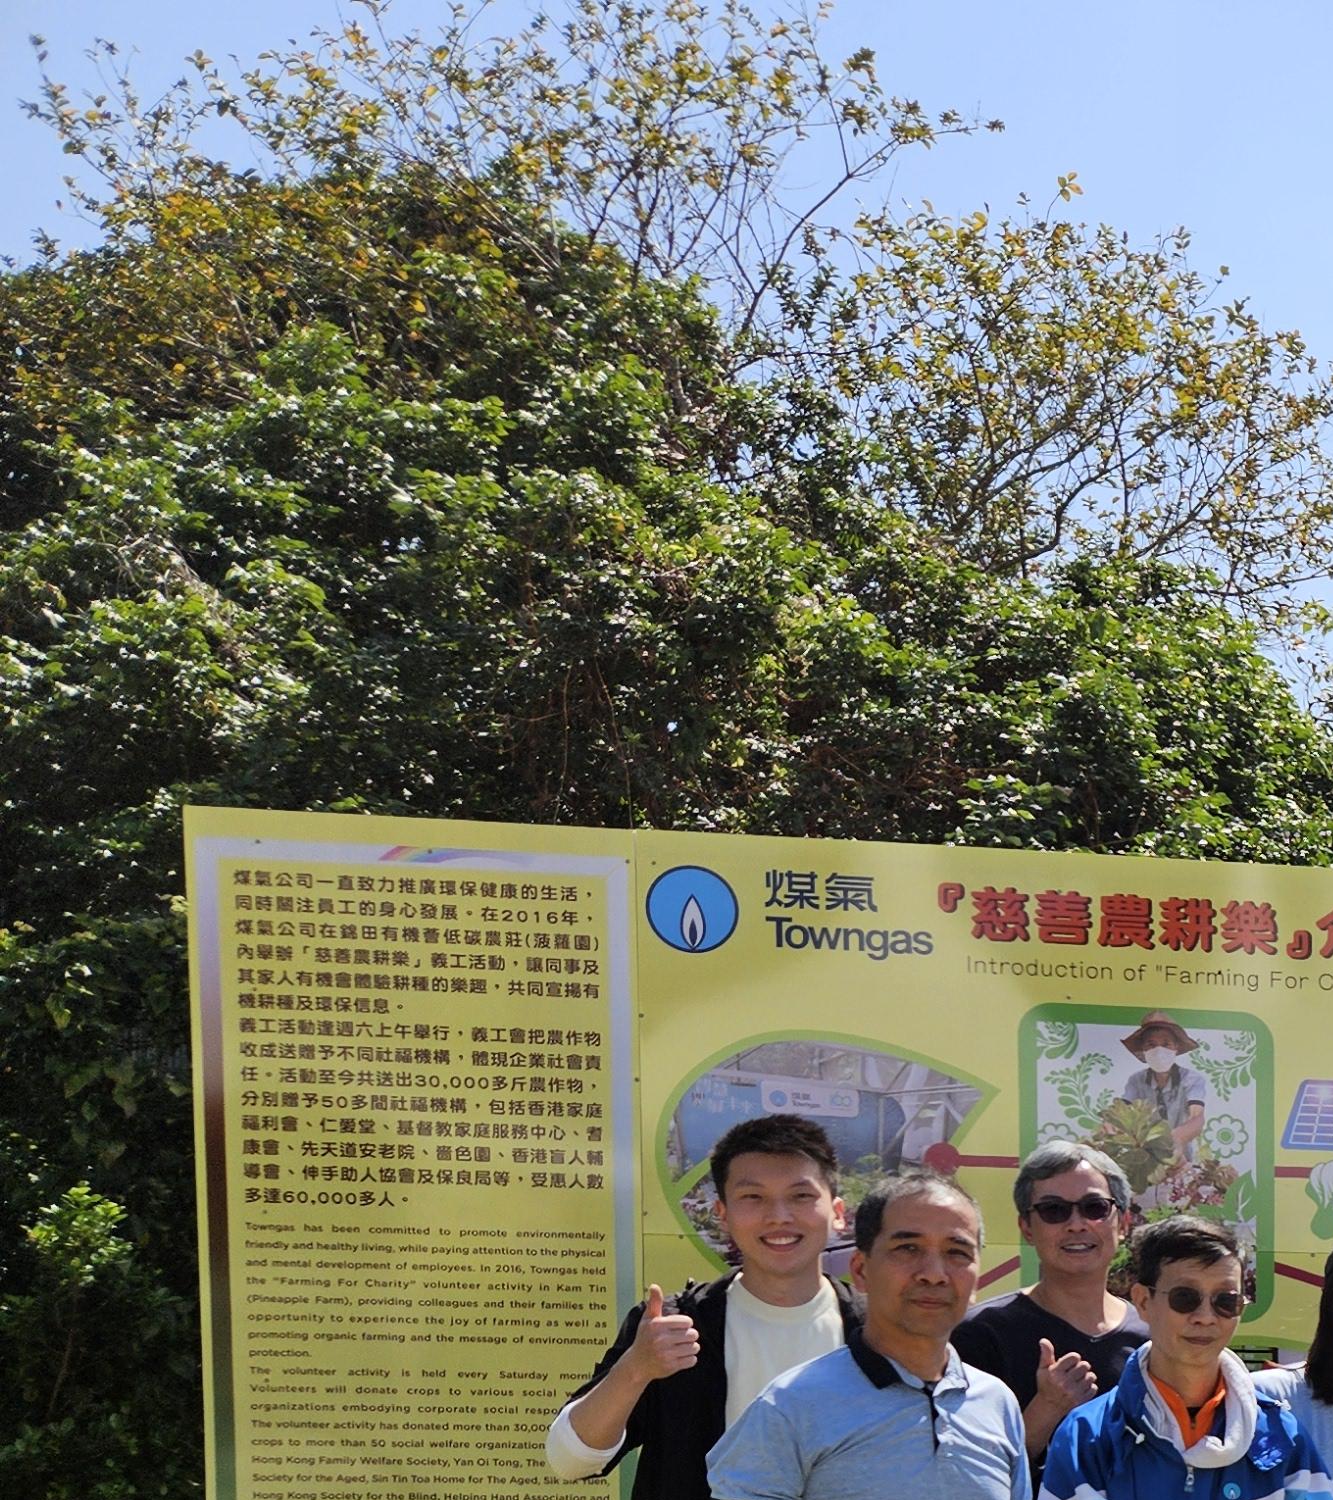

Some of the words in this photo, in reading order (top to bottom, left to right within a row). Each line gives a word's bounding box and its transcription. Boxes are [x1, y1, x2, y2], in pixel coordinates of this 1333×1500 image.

[765, 869, 878, 912] 煤氣
[765, 916, 934, 961] Towngas
[966, 955, 1113, 981] Introduction
[1123, 964, 1147, 982] of
[1155, 964, 1260, 992] "Farming
[1270, 970, 1310, 990] For
[245, 1221, 294, 1233] Towngas
[303, 1223, 323, 1232] has
[331, 1224, 360, 1233] been
[368, 1225, 430, 1235] committed
[458, 1228, 507, 1239] promote
[515, 1229, 605, 1241] environmentally
[244, 1239, 289, 1250] friendly
[292, 1241, 314, 1250] and
[316, 1241, 359, 1252] healthy
[398, 1244, 428, 1252] while
[430, 1245, 470, 1256] paying
[472, 1245, 524, 1257] attention
[560, 1247, 605, 1259] physical
[245, 1258, 268, 1267] and
[272, 1259, 311, 1268] mental
[315, 1260, 391, 1271] development
[529, 1264, 578, 1276] Towngas
[581, 1266, 606, 1276] held
[246, 1276, 266, 1284] the
[337, 1277, 358, 1287] For
[423, 1280, 480, 1290] volunteer
[487, 1281, 533, 1293] activity
[556, 1283, 582, 1292] Kam
[588, 1283, 606, 1293] Tin
[246, 1294, 309, 1304] (Pineapple
[357, 1296, 412, 1308] providing
[417, 1297, 478, 1309] colleagues
[483, 1298, 504, 1308] and
[509, 1299, 535, 1309] their
[540, 1300, 584, 1310] families
[588, 1302, 607, 1310] the
[247, 1312, 324, 1323] opportunity
[348, 1315, 419, 1325] experience
[449, 1315, 469, 1327] joy
[492, 1316, 540, 1328] farming
[564, 1318, 589, 1327] well
[248, 1331, 308, 1341] promoting
[313, 1332, 357, 1342] organic
[361, 1332, 405, 1343] farming
[410, 1332, 432, 1342] and
[435, 1333, 454, 1343] the
[458, 1335, 508, 1345] message
[528, 1335, 608, 1346] environmental
[249, 1366, 270, 1374] The
[282, 1367, 336, 1376] volunteer
[347, 1367, 390, 1378] activity
[421, 1368, 446, 1378] held
[457, 1370, 488, 1380] every
[499, 1370, 548, 1381] Saturday
[250, 1383, 317, 1394] Volunteers
[325, 1385, 346, 1393] will
[354, 1385, 398, 1395] donate
[406, 1387, 440, 1397] crops
[470, 1386, 514, 1397] various
[522, 1388, 557, 1397] social
[250, 1402, 335, 1412] organizations
[341, 1403, 410, 1414] embodying
[416, 1404, 476, 1415] corporate
[483, 1404, 518, 1415] social
[251, 1419, 272, 1428] The
[276, 1420, 330, 1429] volunteer
[333, 1421, 376, 1431] activity
[379, 1421, 398, 1430] has
[402, 1420, 450, 1431] donated
[452, 1423, 482, 1431] more
[484, 1422, 510, 1432] than
[250, 1438, 283, 1447] crops
[340, 1438, 366, 1447] than
[391, 1438, 424, 1448] social
[429, 1438, 470, 1449] welfare
[252, 1455, 282, 1465] Hong
[286, 1455, 315, 1466] Kong
[318, 1456, 356, 1466] Family
[359, 1456, 403, 1465] Welfare
[452, 1457, 474, 1466] Yan
[525, 1458, 546, 1467] The
[252, 1473, 293, 1482] Society
[371, 1474, 388, 1483] Sin
[391, 1474, 408, 1483] Tin
[433, 1474, 465, 1484] Home
[468, 1474, 484, 1484] for
[486, 1474, 506, 1484] The
[543, 1475, 559, 1485] Sik
[253, 1492, 283, 1500] Hong
[287, 1491, 317, 1500] Kong
[320, 1491, 363, 1500] Society
[366, 1491, 383, 1500] for
[386, 1492, 404, 1500] the
